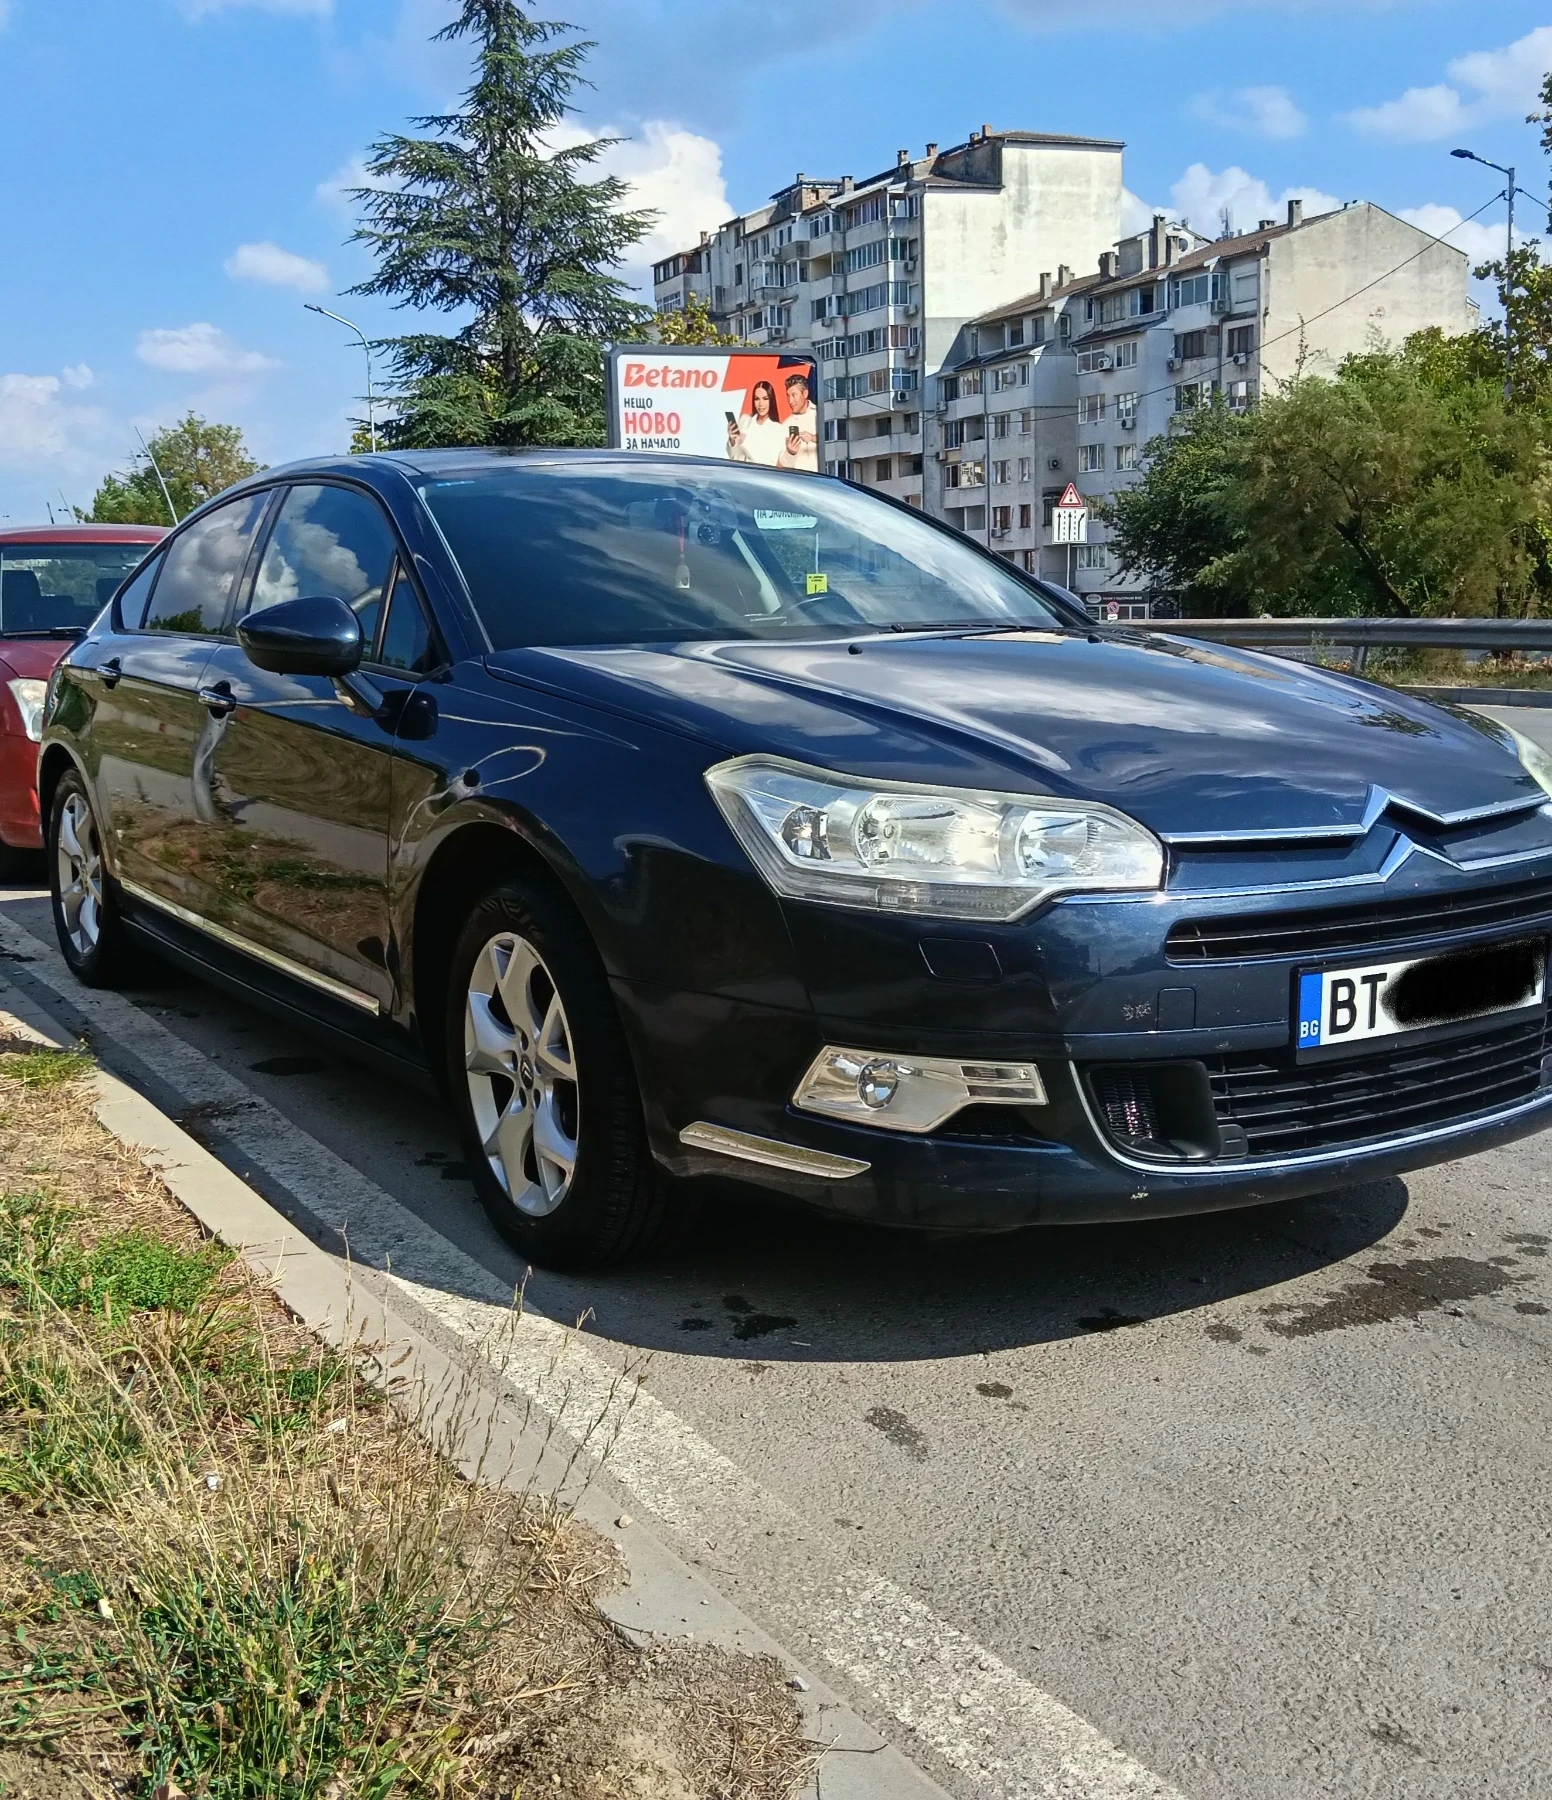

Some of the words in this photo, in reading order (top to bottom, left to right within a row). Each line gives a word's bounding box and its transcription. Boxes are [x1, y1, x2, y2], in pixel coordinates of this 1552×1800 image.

[624, 364, 718, 388] Betano
[624, 397, 653, 410] НЕЩО
[624, 412, 681, 434] НОВО
[626, 438, 638, 449] ЗА
[641, 438, 680, 449] НАЧАЛО
[1300, 1020, 1320, 1039] BG
